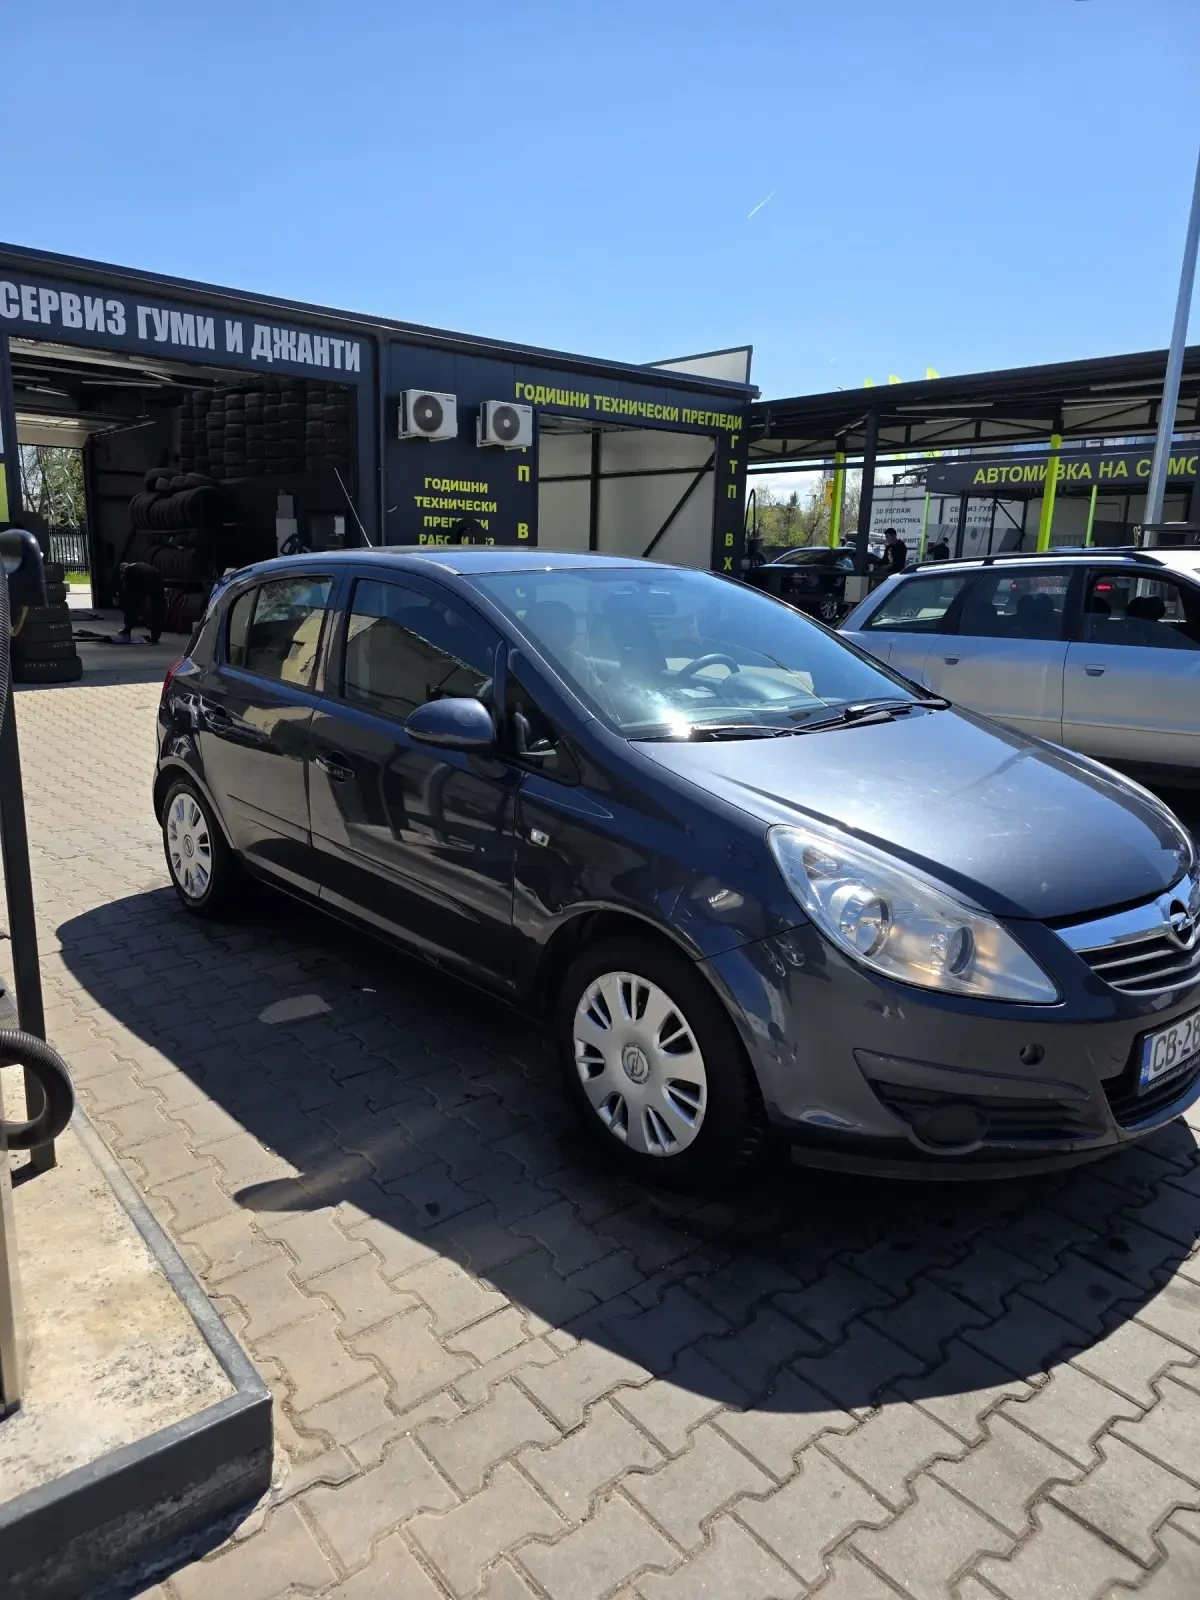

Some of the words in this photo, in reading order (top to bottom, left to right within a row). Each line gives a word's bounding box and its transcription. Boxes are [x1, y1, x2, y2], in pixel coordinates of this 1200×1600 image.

[0, 281, 126, 336] СЕРВИЗ
[137, 305, 215, 350] ГУМИ
[225, 319, 243, 354] И
[251, 324, 361, 373] ДЖАНТИ
[515, 382, 590, 409] ГОДИШНИ
[593, 395, 679, 422] ТЕХНИЧЕСКИ
[682, 408, 743, 431] ПРЕГЛЕДИ
[1098, 460, 1128, 479] НА
[424, 477, 488, 494] ГОДИШНИ
[414, 495, 497, 513] ТЕХНИЧЕСКИ
[423, 515, 489, 530] ПРЕГИ
